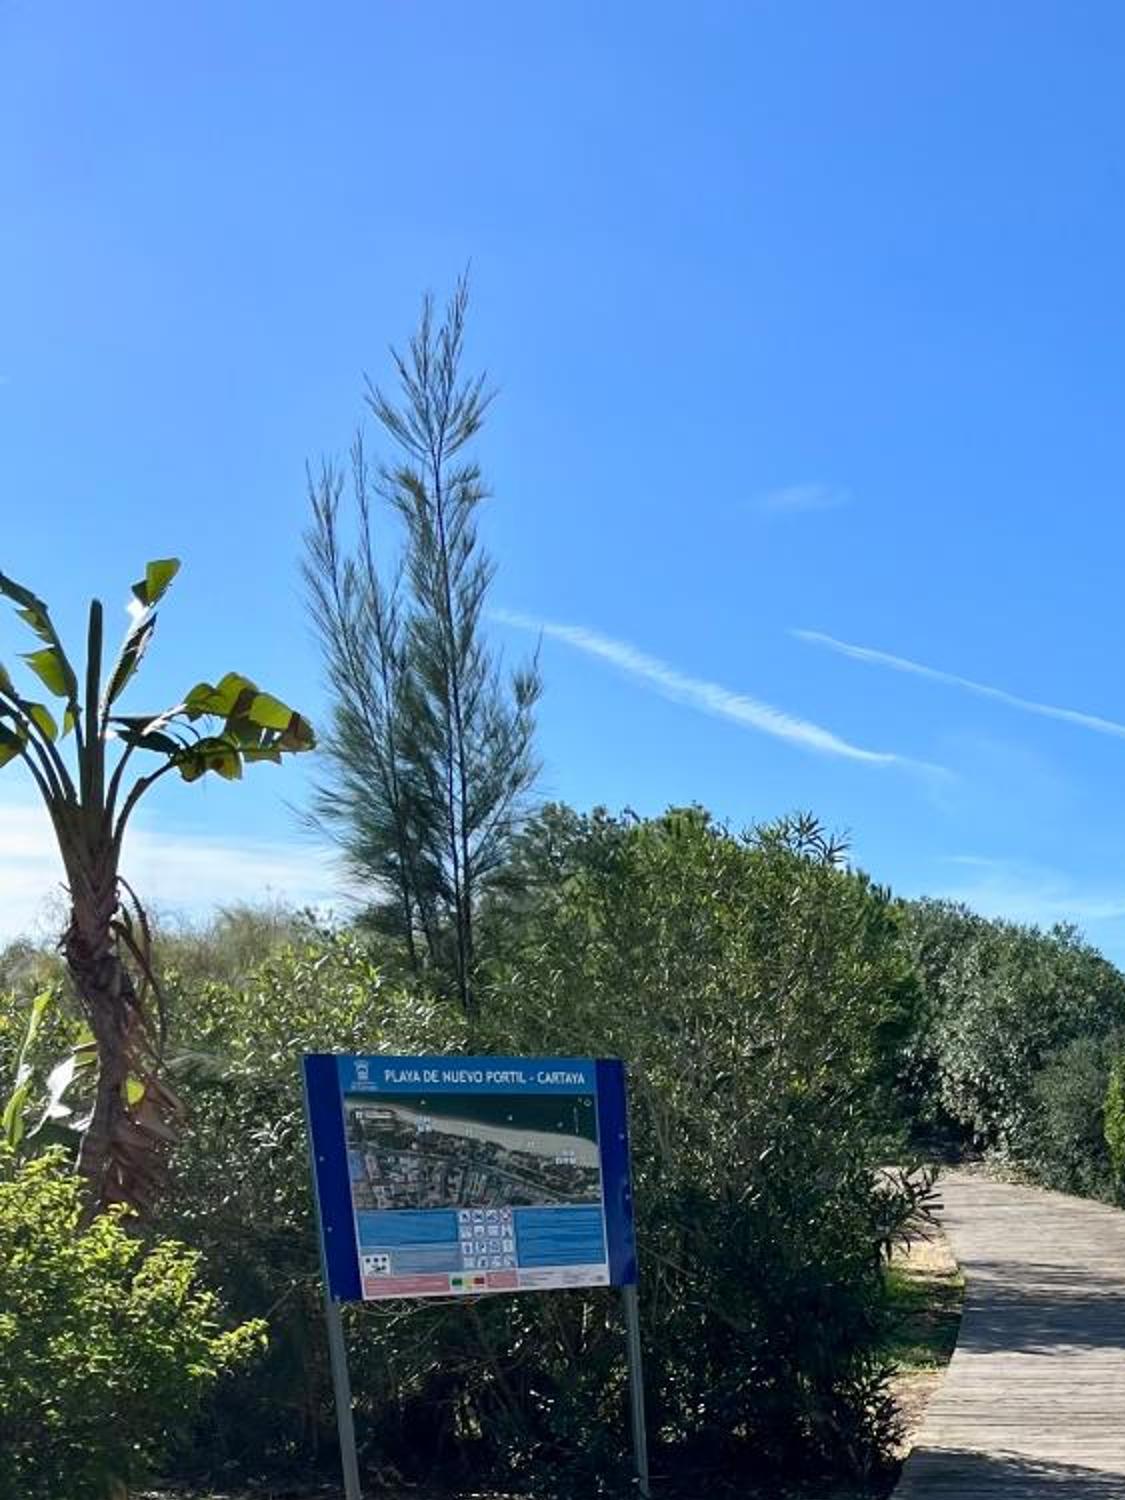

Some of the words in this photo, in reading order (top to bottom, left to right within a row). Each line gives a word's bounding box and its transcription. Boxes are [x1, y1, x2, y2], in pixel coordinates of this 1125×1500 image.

[384, 1069, 420, 1083] PLAYA
[423, 1070, 439, 1083] DE
[442, 1070, 483, 1083] NUEVO
[486, 1070, 526, 1084] PORTIL
[537, 1070, 585, 1085] CARTAYA
